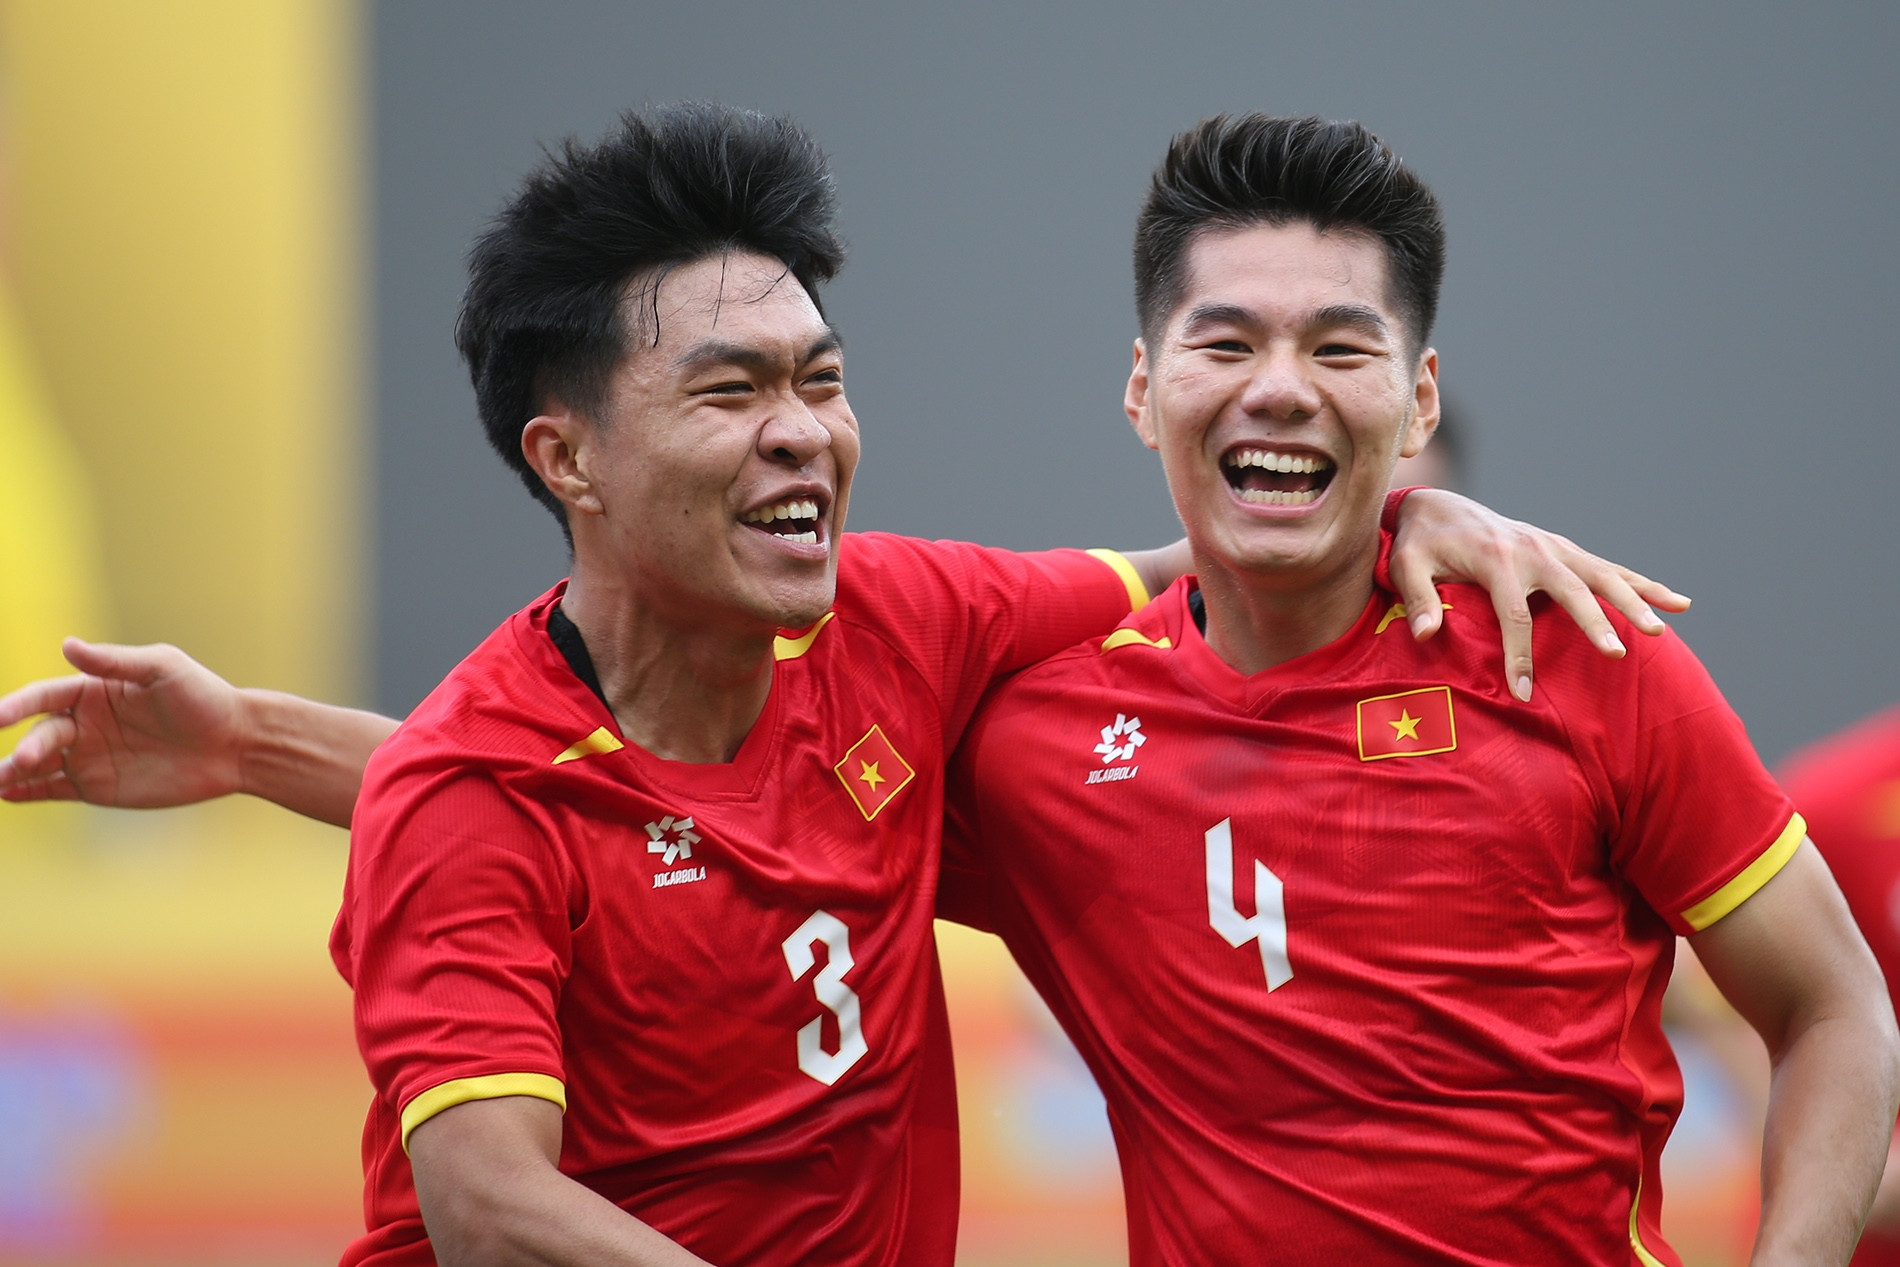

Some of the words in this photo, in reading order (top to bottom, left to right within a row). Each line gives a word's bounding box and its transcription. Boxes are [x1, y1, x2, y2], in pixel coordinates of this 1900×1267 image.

[1084, 765, 1139, 785] JOGARBOLA
[652, 866, 707, 889] JOGARBOLA
[1204, 817, 1294, 994] 4
[781, 912, 869, 1086] 3
